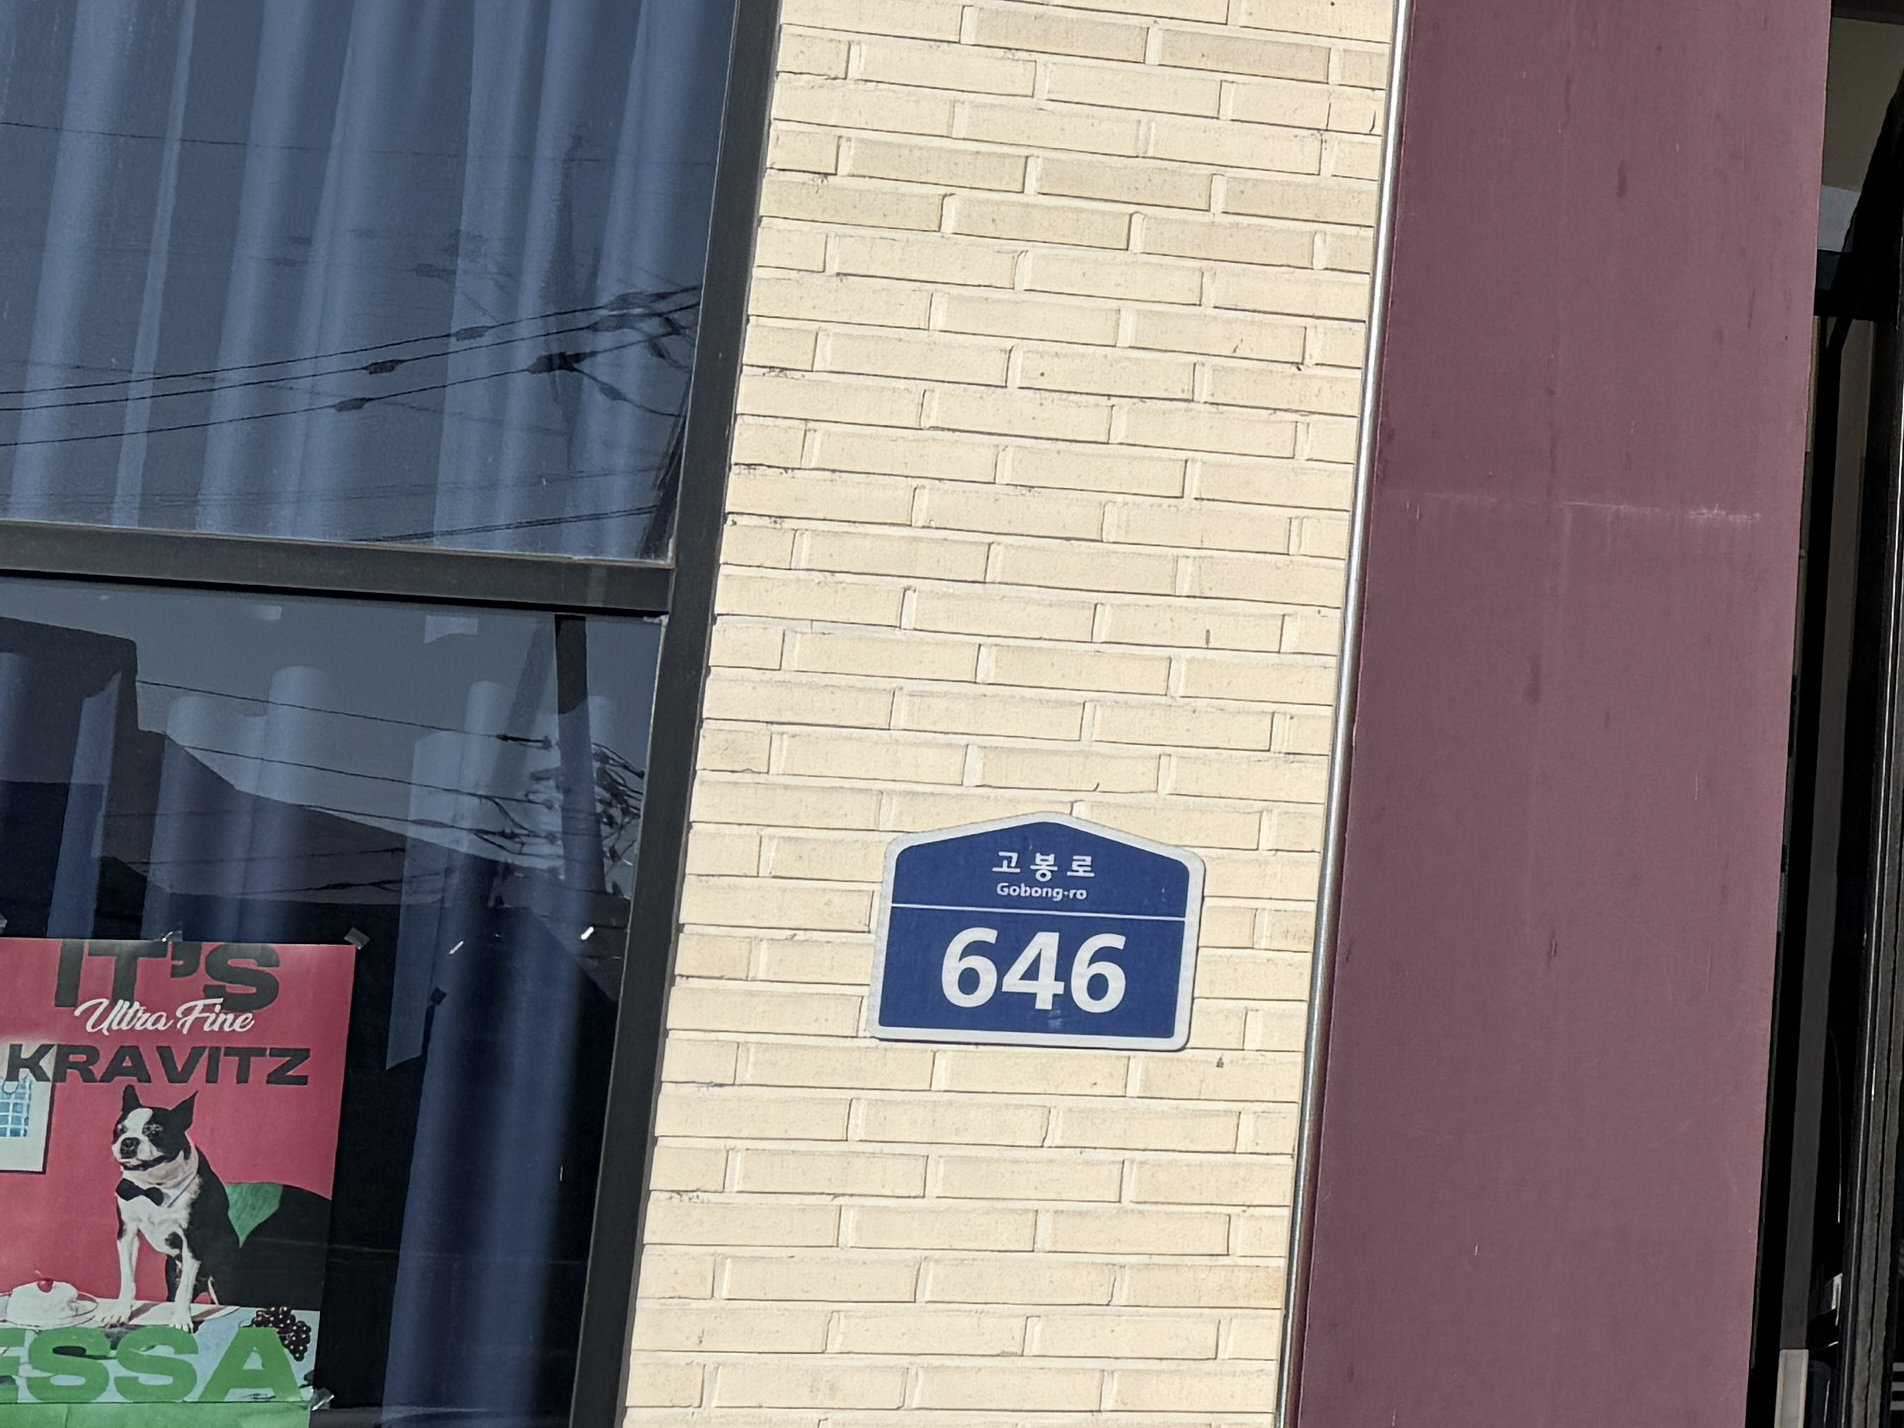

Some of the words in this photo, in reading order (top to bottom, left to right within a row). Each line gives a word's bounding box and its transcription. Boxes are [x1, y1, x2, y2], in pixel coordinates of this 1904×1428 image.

[992, 851, 1095, 882] 고봉로
[996, 882, 1088, 901] Gobong-ro
[54, 940, 281, 1013] IT'S
[941, 927, 1127, 1013] 646
[74, 998, 178, 1036] Ultra
[176, 998, 255, 1035] Fine
[6, 1043, 311, 1085] KRAVITZ
